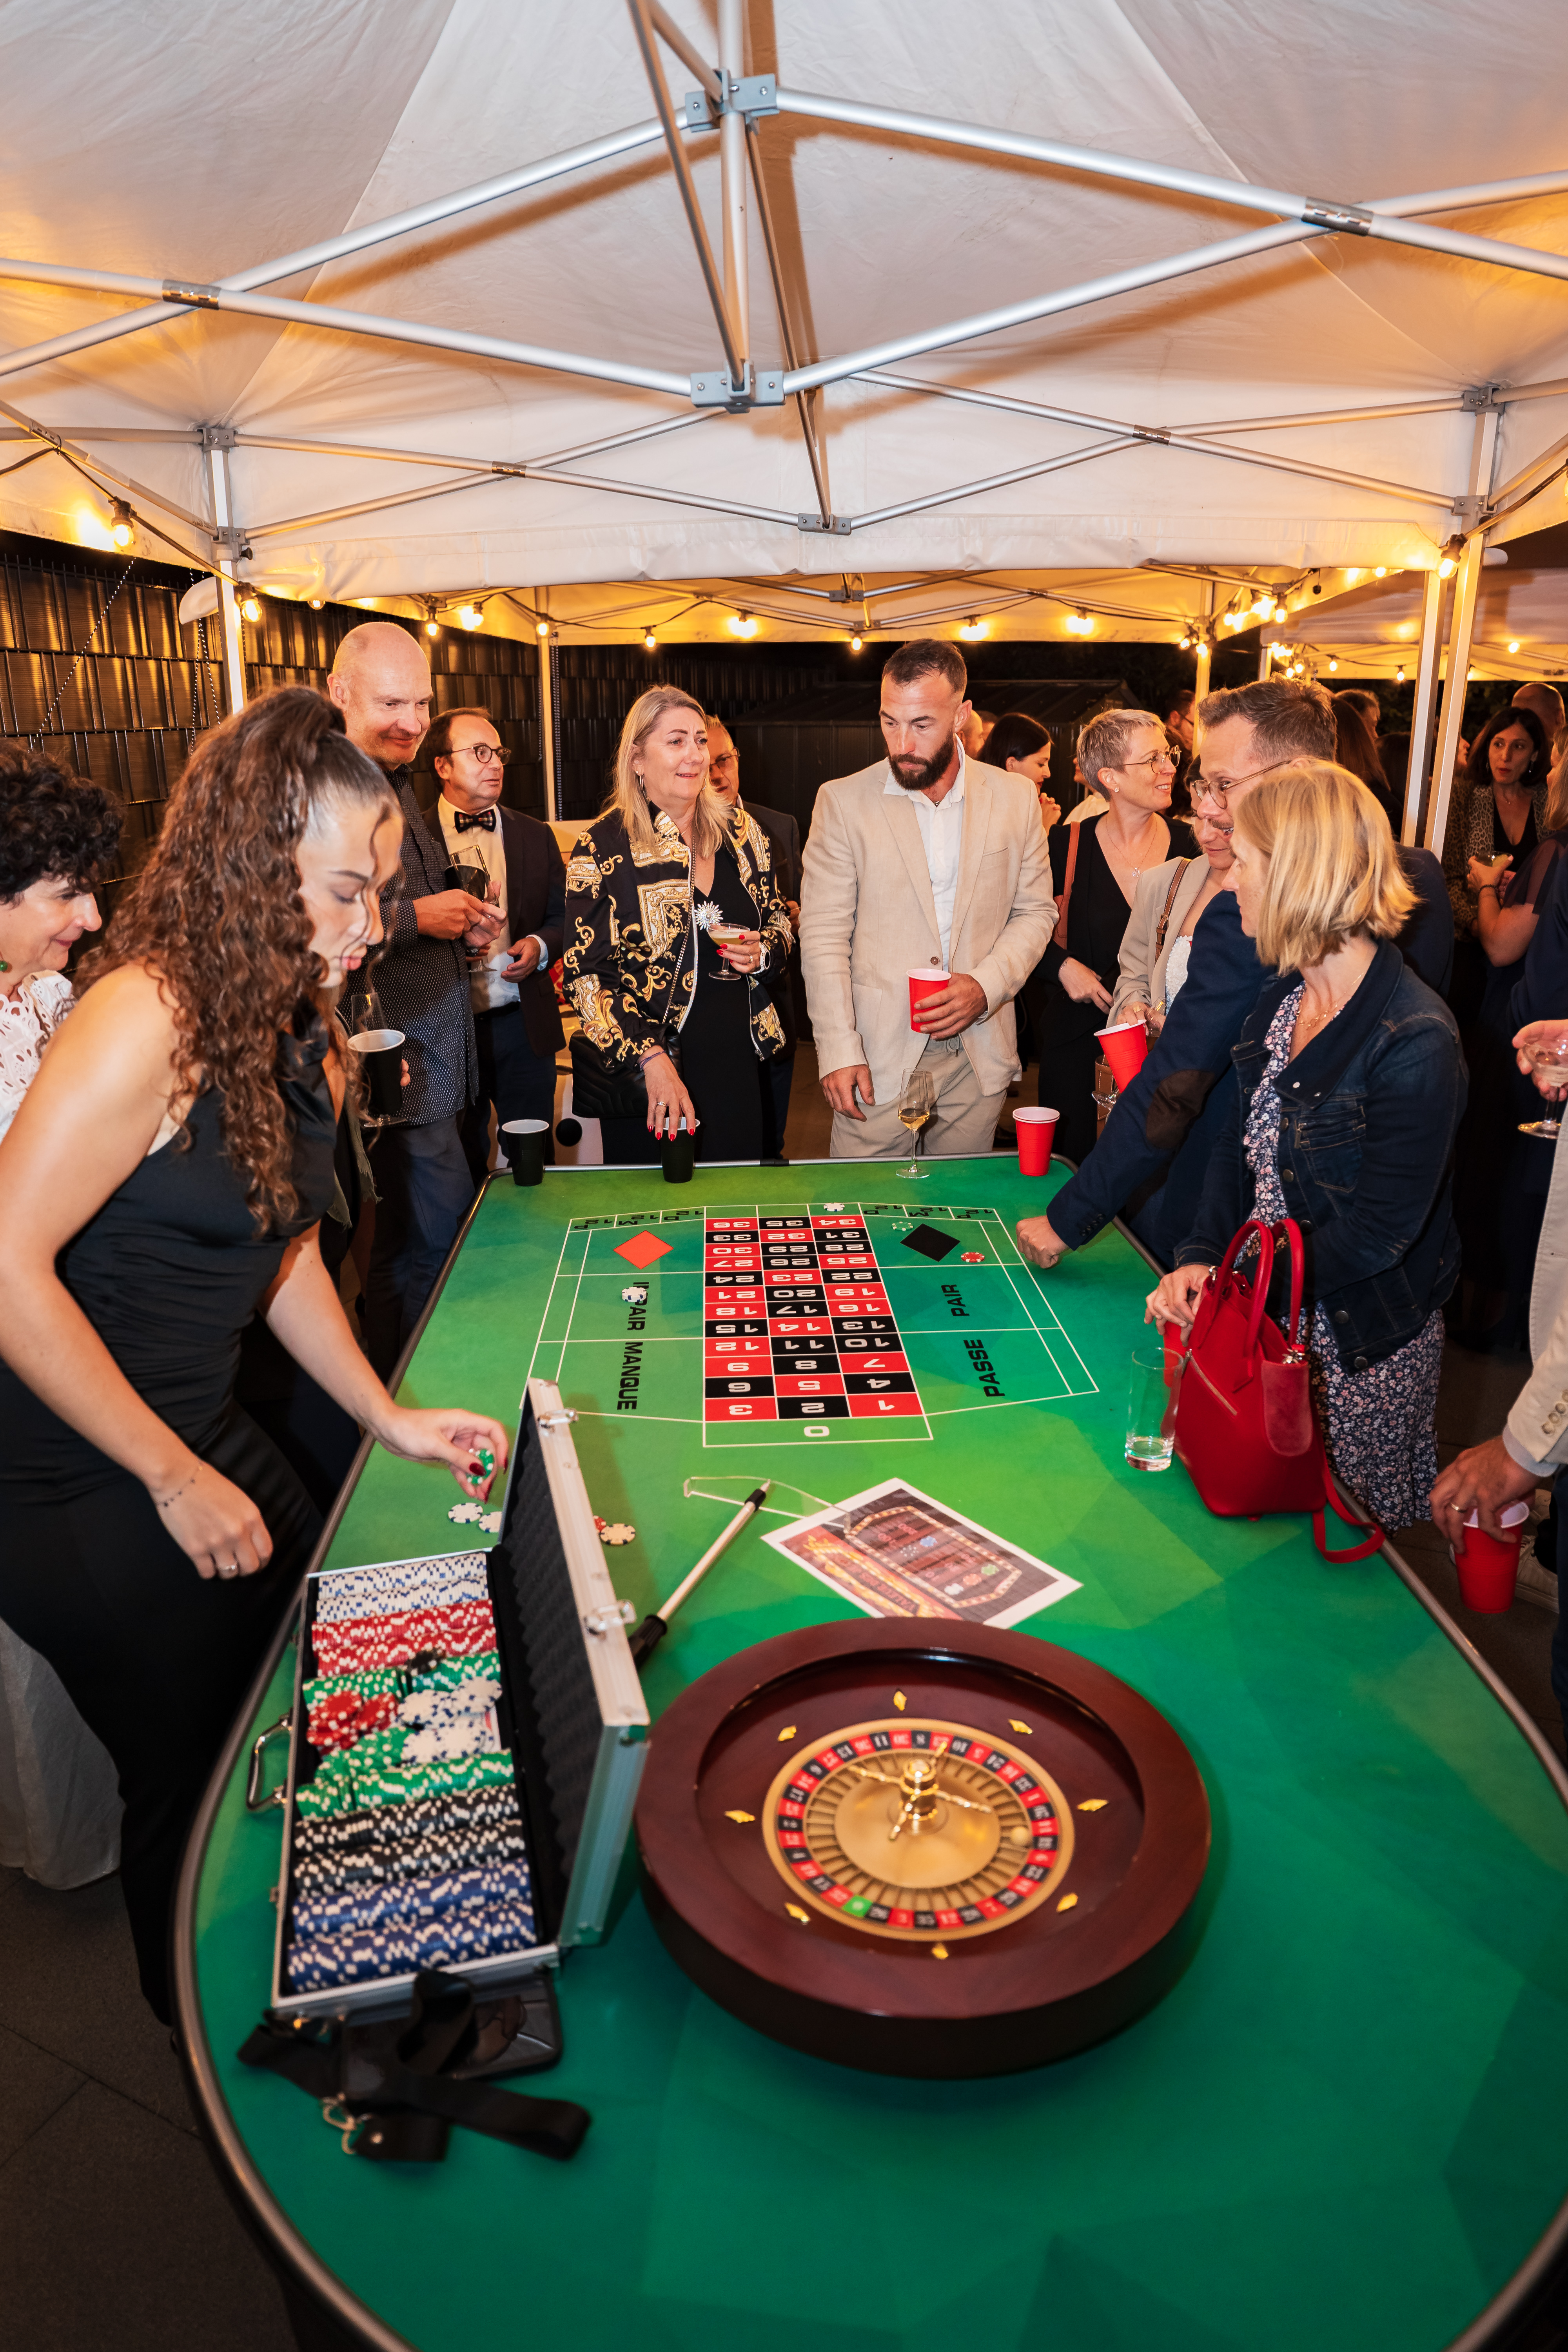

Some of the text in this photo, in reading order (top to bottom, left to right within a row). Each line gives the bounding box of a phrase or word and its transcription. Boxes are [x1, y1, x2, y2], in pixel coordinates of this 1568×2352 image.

[719, 1291, 756, 1299] 21
[773, 1289, 816, 1298] 20
[941, 1284, 970, 1316] PAIR
[716, 1307, 757, 1316] 18
[776, 1305, 818, 1314] 17
[838, 1304, 880, 1312] 16
[715, 1324, 758, 1333] 15
[777, 1323, 821, 1332] 14
[842, 1321, 886, 1330] 13
[715, 1342, 759, 1351] 12
[785, 1340, 824, 1349] 11
[845, 1338, 890, 1348] 10
[728, 1362, 749, 1372] 9
[795, 1360, 817, 1369] 8
[863, 1358, 886, 1368] 7
[964, 1339, 1005, 1397] PASSE
[617, 1342, 643, 1410] MANQUE
[728, 1382, 751, 1392] 6
[798, 1381, 820, 1390] 5
[867, 1379, 891, 1388] 4
[801, 1403, 825, 1413] 2
[878, 1400, 895, 1410] 1
[729, 1405, 752, 1415] 3
[804, 1426, 829, 1437] 0
